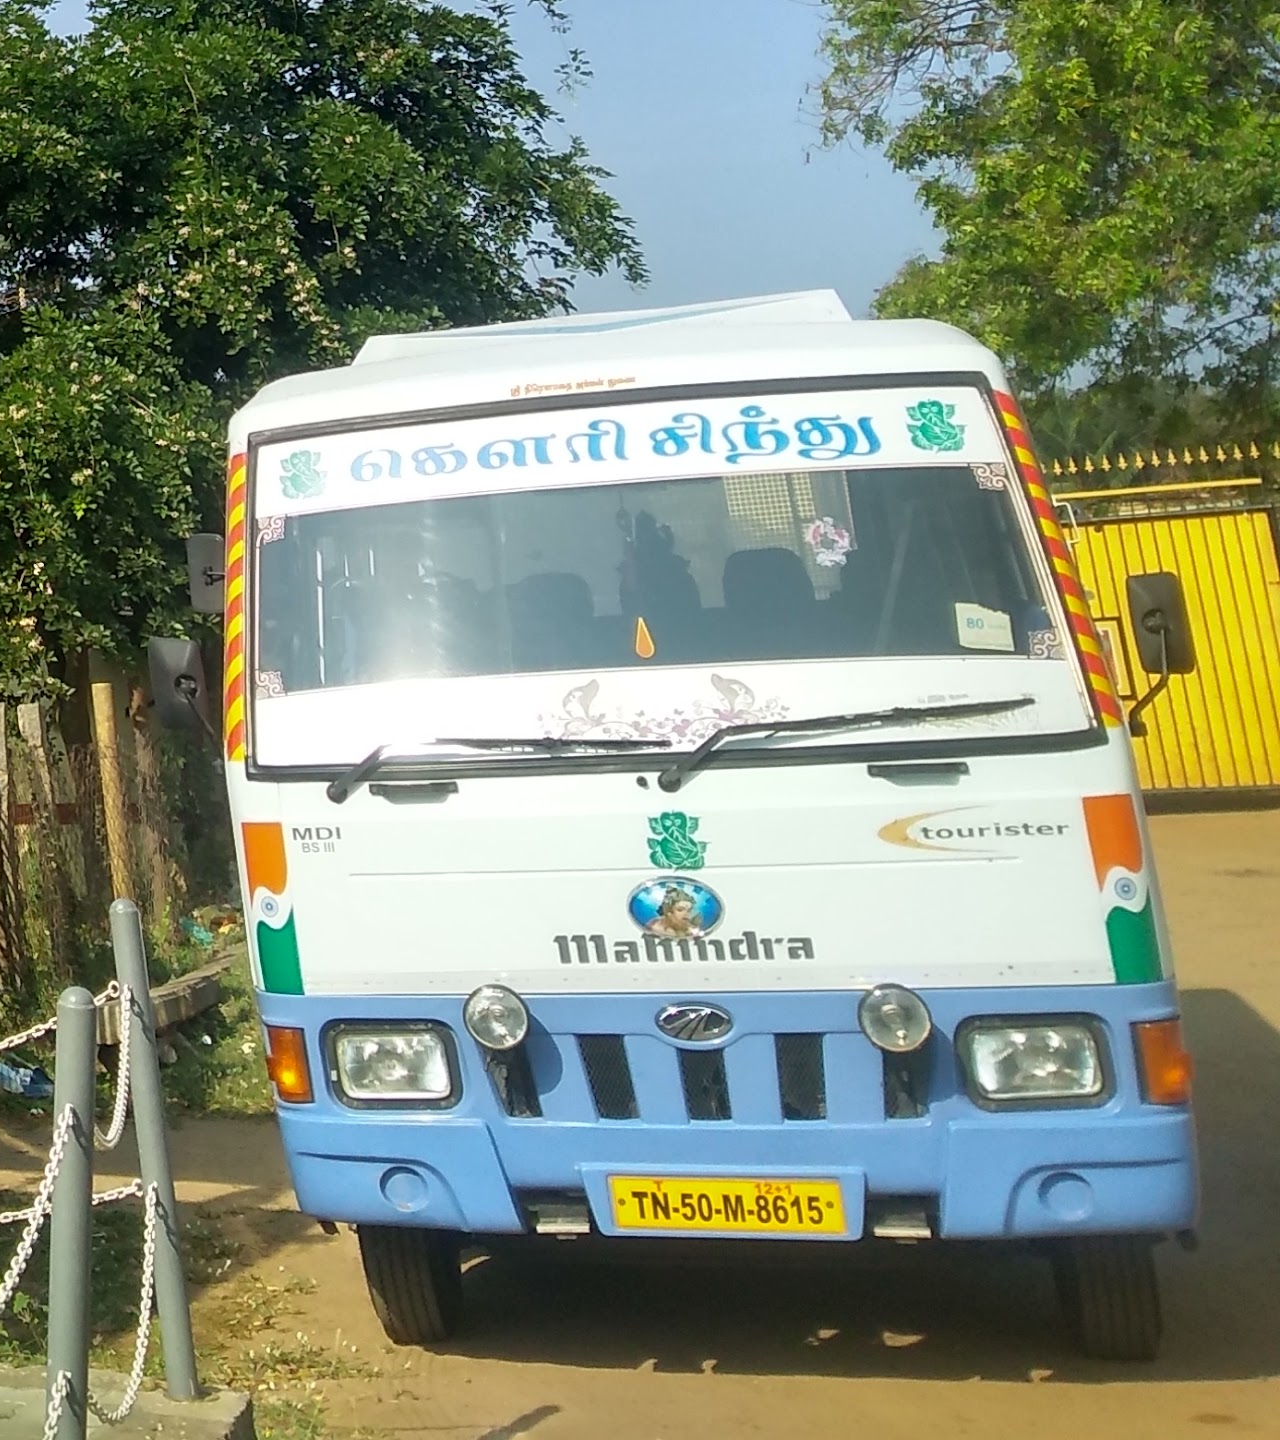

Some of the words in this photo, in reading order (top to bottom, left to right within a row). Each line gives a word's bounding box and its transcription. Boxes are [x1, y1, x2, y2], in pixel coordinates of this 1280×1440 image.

[648, 405, 882, 465] சிந்து
[292, 826, 342, 841] MDI
[920, 822, 1069, 840] tourister
[301, 842, 320, 853] BS
[631, 1191, 824, 1225] TN-50-M-8615
